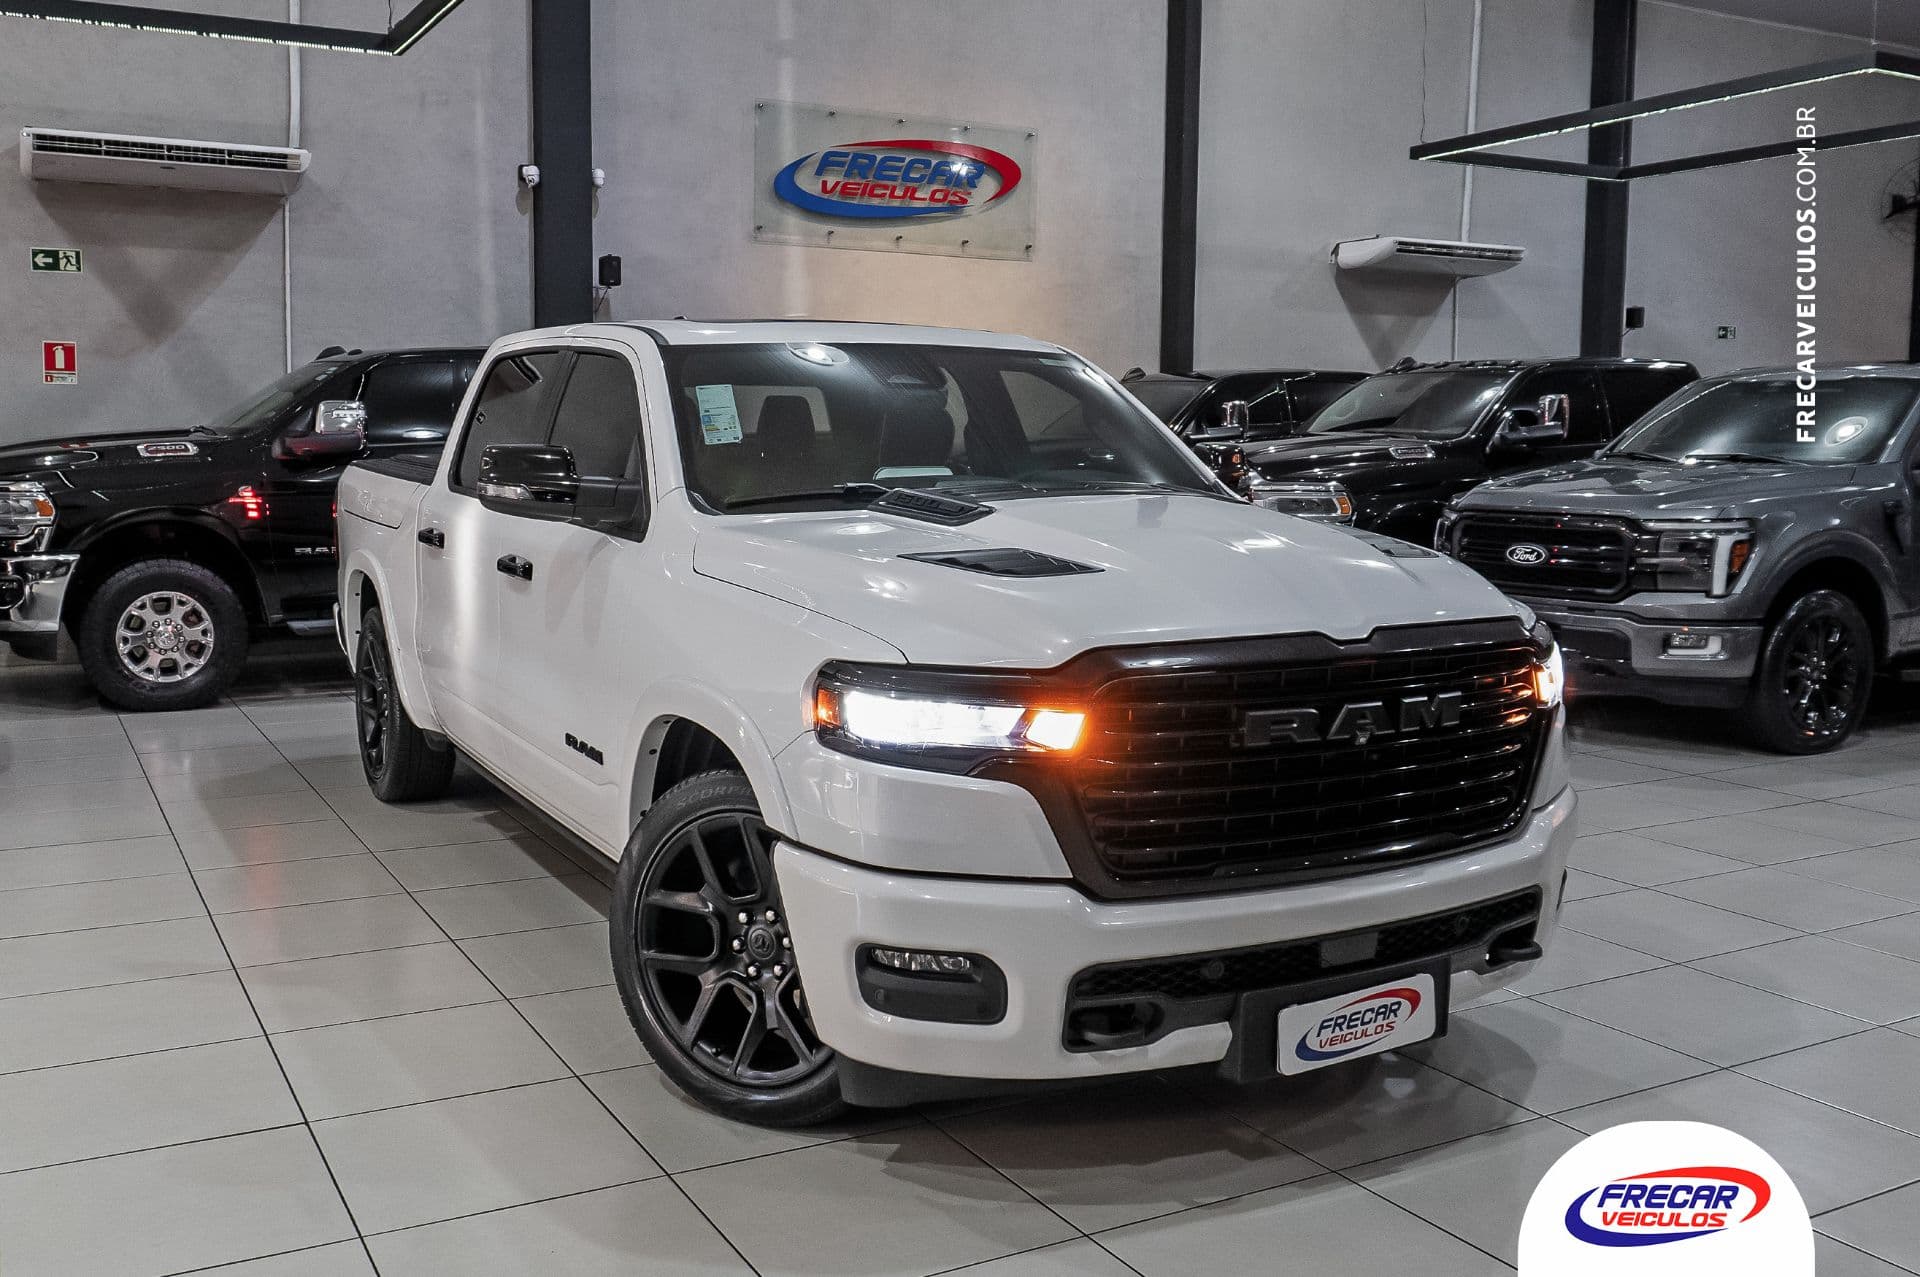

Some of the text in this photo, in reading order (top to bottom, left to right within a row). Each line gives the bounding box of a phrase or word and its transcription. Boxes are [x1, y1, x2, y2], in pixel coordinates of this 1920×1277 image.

[814, 150, 985, 189] FRECAR
[1513, 547, 1538, 561] Ford
[1244, 691, 1462, 746] RAM
[565, 732, 604, 766] RAM
[1315, 1000, 1402, 1038] FRECAR
[1318, 1021, 1396, 1049] VEICULOS
